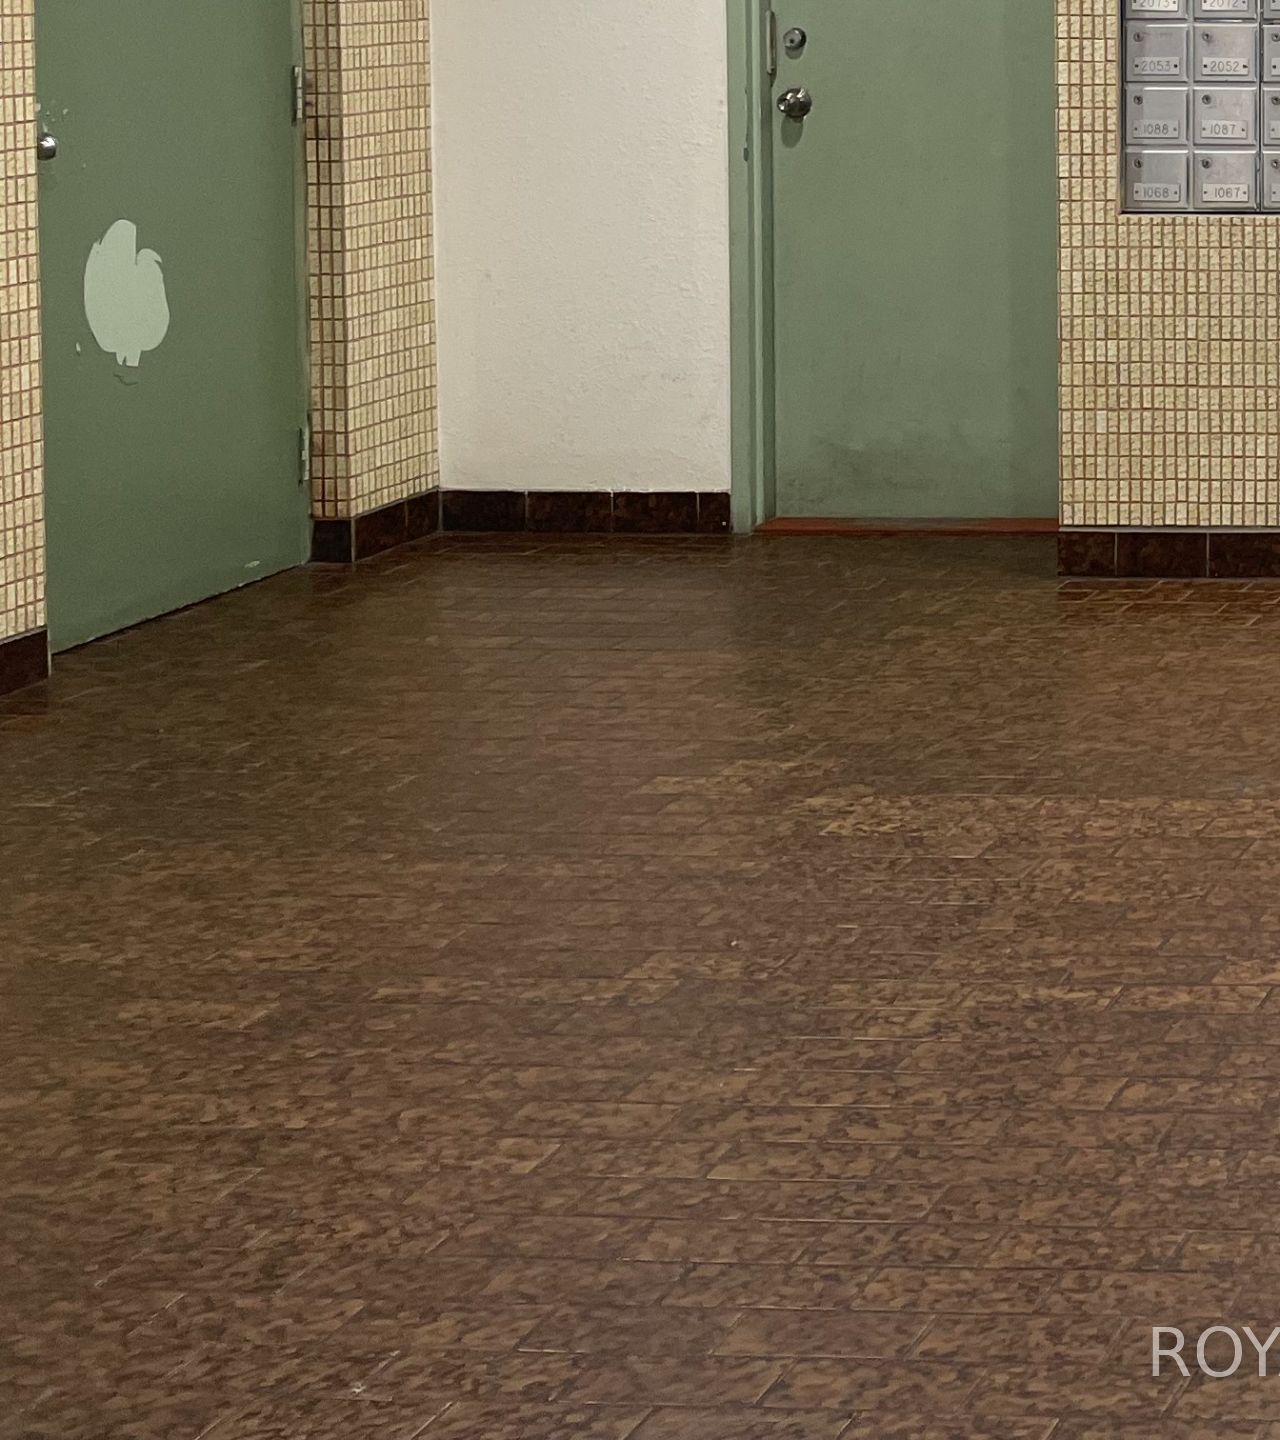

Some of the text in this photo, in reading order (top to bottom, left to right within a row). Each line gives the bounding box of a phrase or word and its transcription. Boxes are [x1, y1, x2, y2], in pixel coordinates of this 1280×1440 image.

[1140, 60, 1172, 72] 2053
[1209, 60, 1241, 73] 2052
[1144, 123, 1169, 136] 1088
[1210, 123, 1237, 136] 1087
[1143, 186, 1170, 199] 1068
[1214, 186, 1241, 199] 1067
